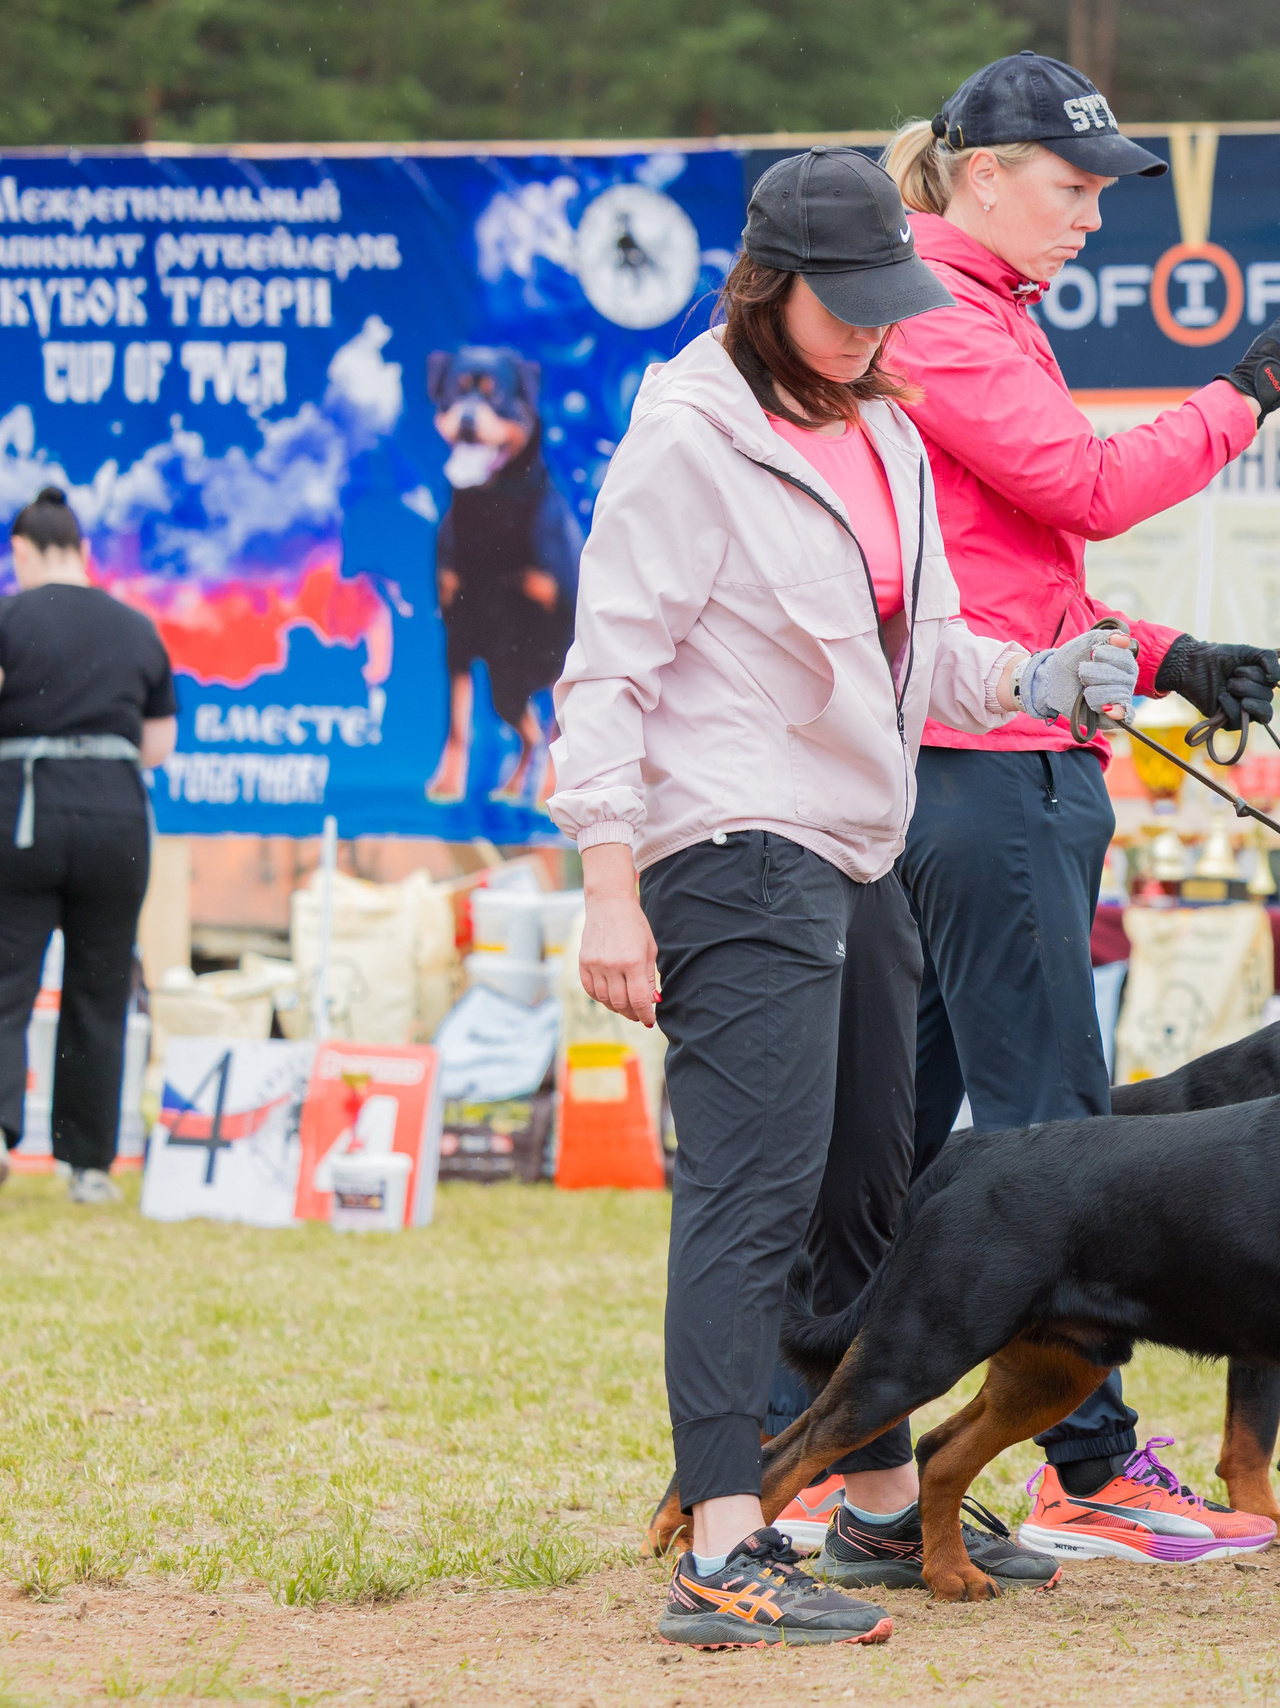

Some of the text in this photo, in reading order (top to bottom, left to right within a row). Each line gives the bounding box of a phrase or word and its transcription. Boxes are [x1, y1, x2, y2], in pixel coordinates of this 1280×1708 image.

[42, 342, 287, 405] CUP OF TVER
[166, 1047, 233, 1185] 4
